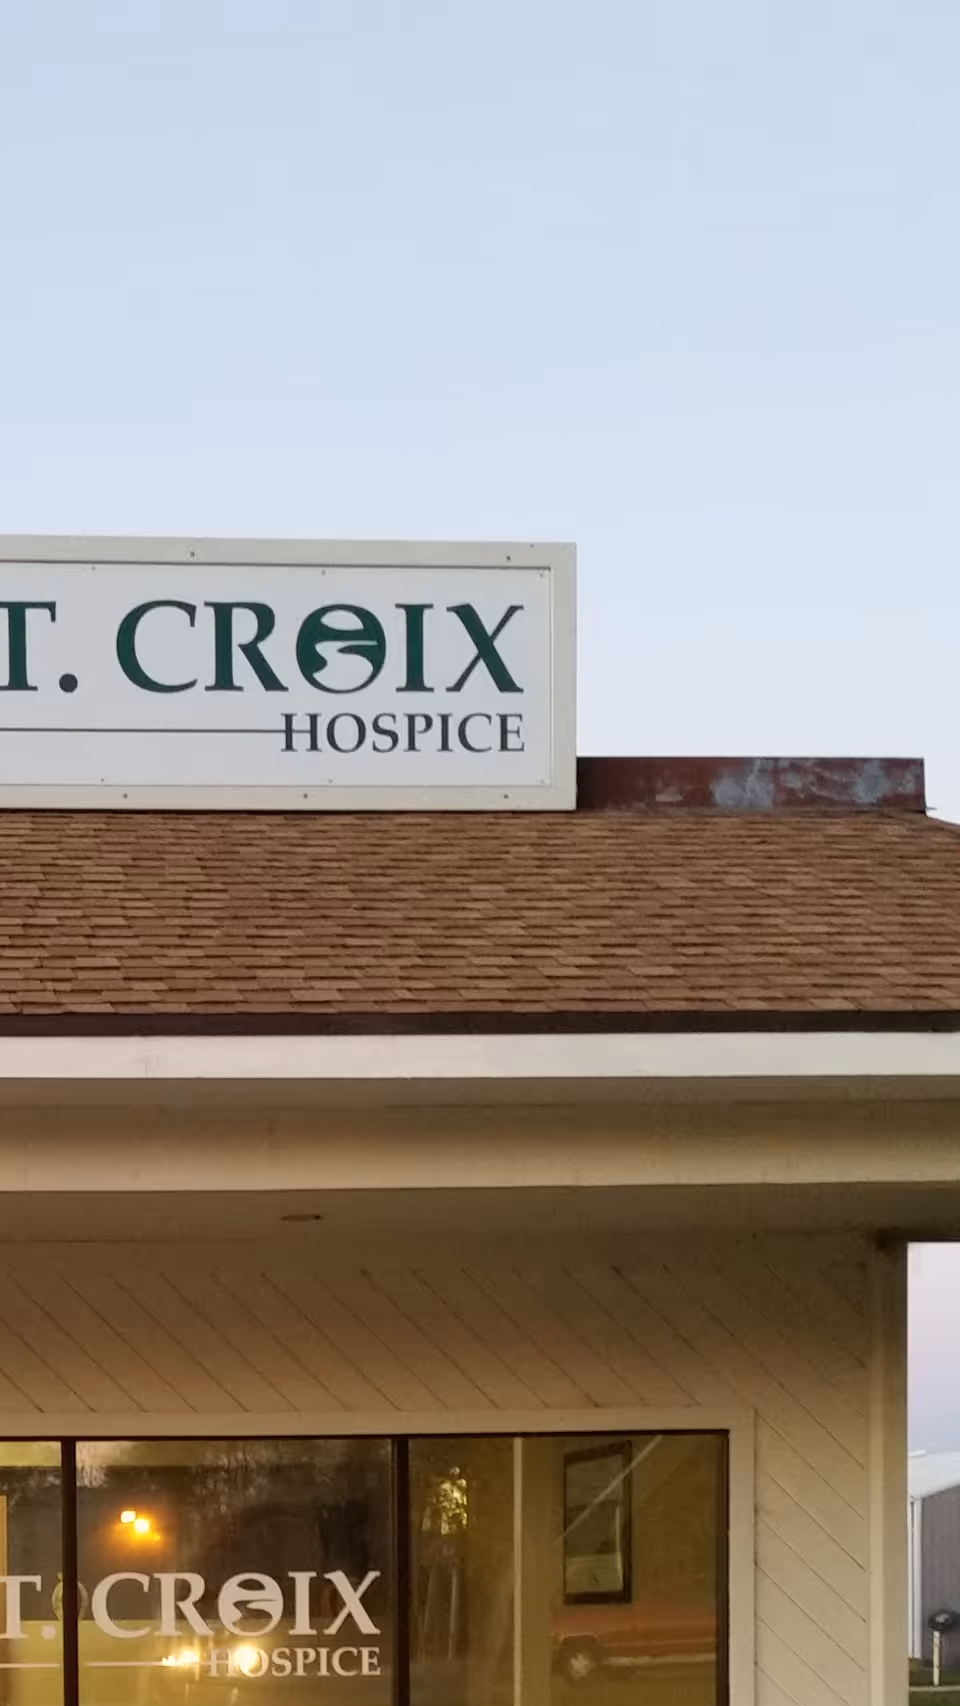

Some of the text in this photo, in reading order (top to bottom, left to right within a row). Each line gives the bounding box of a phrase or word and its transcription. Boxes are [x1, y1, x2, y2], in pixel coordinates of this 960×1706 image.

[115, 599, 525, 694] CROIX
[281, 713, 525, 753] HOSPICE
[92, 1570, 381, 1637] CROIX
[208, 1646, 381, 1677] HOSPICE
